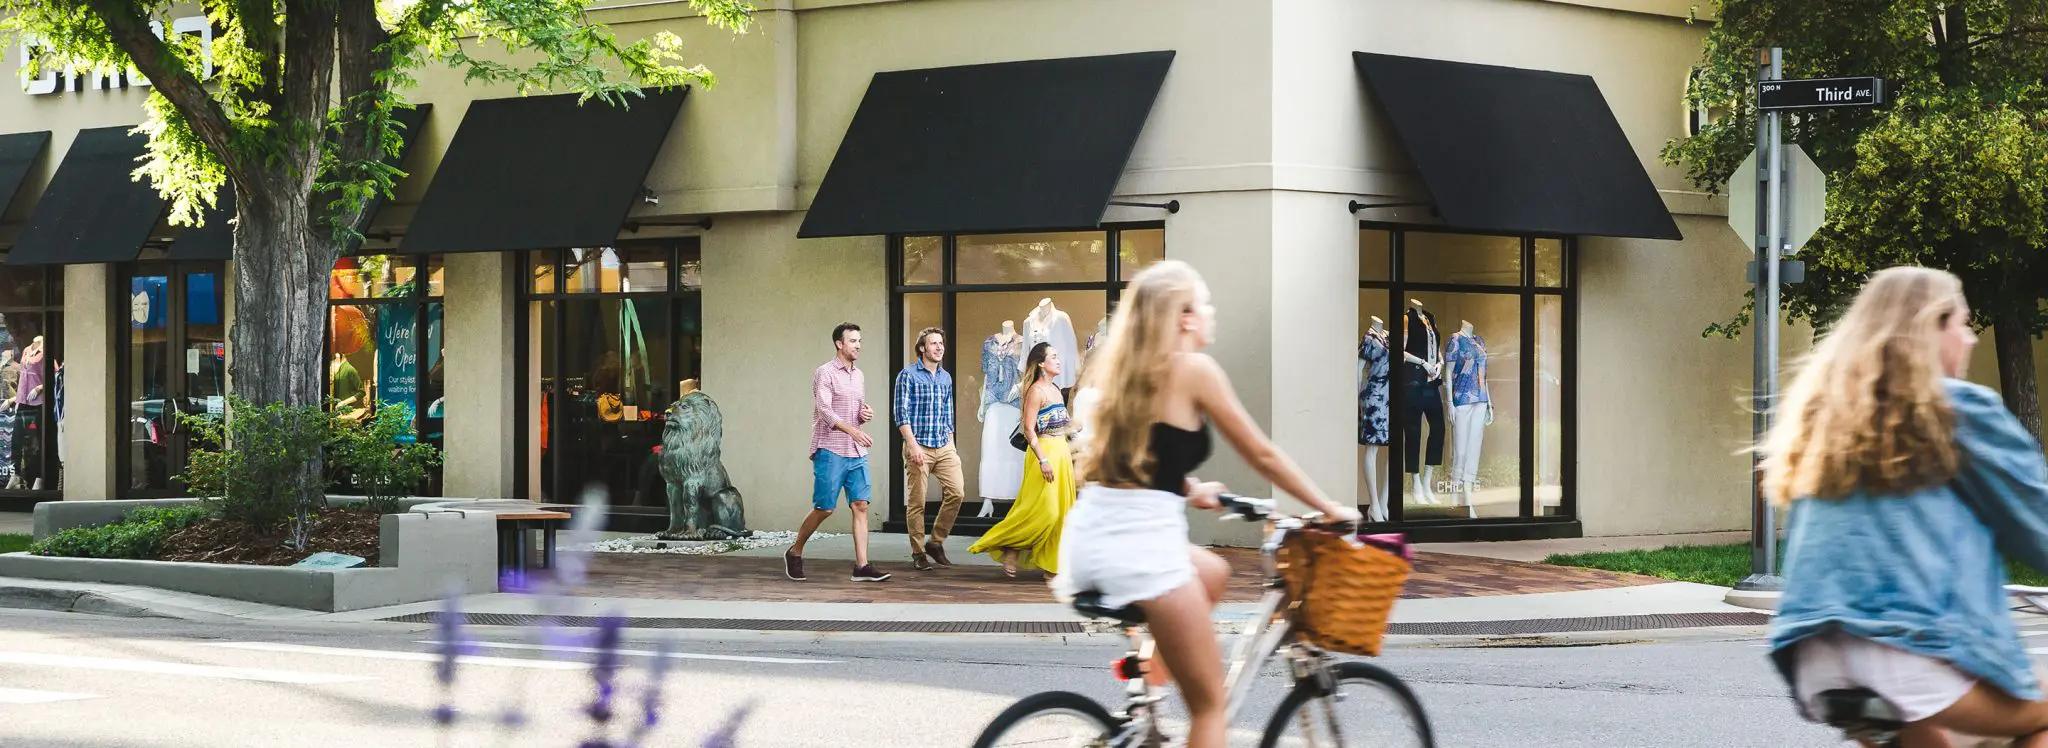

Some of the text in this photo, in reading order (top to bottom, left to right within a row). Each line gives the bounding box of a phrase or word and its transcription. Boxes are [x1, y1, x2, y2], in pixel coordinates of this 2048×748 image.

[1762, 85, 1775, 93] 300
[1816, 86, 1872, 101] Third AVE.
[388, 386, 408, 394] waiting
